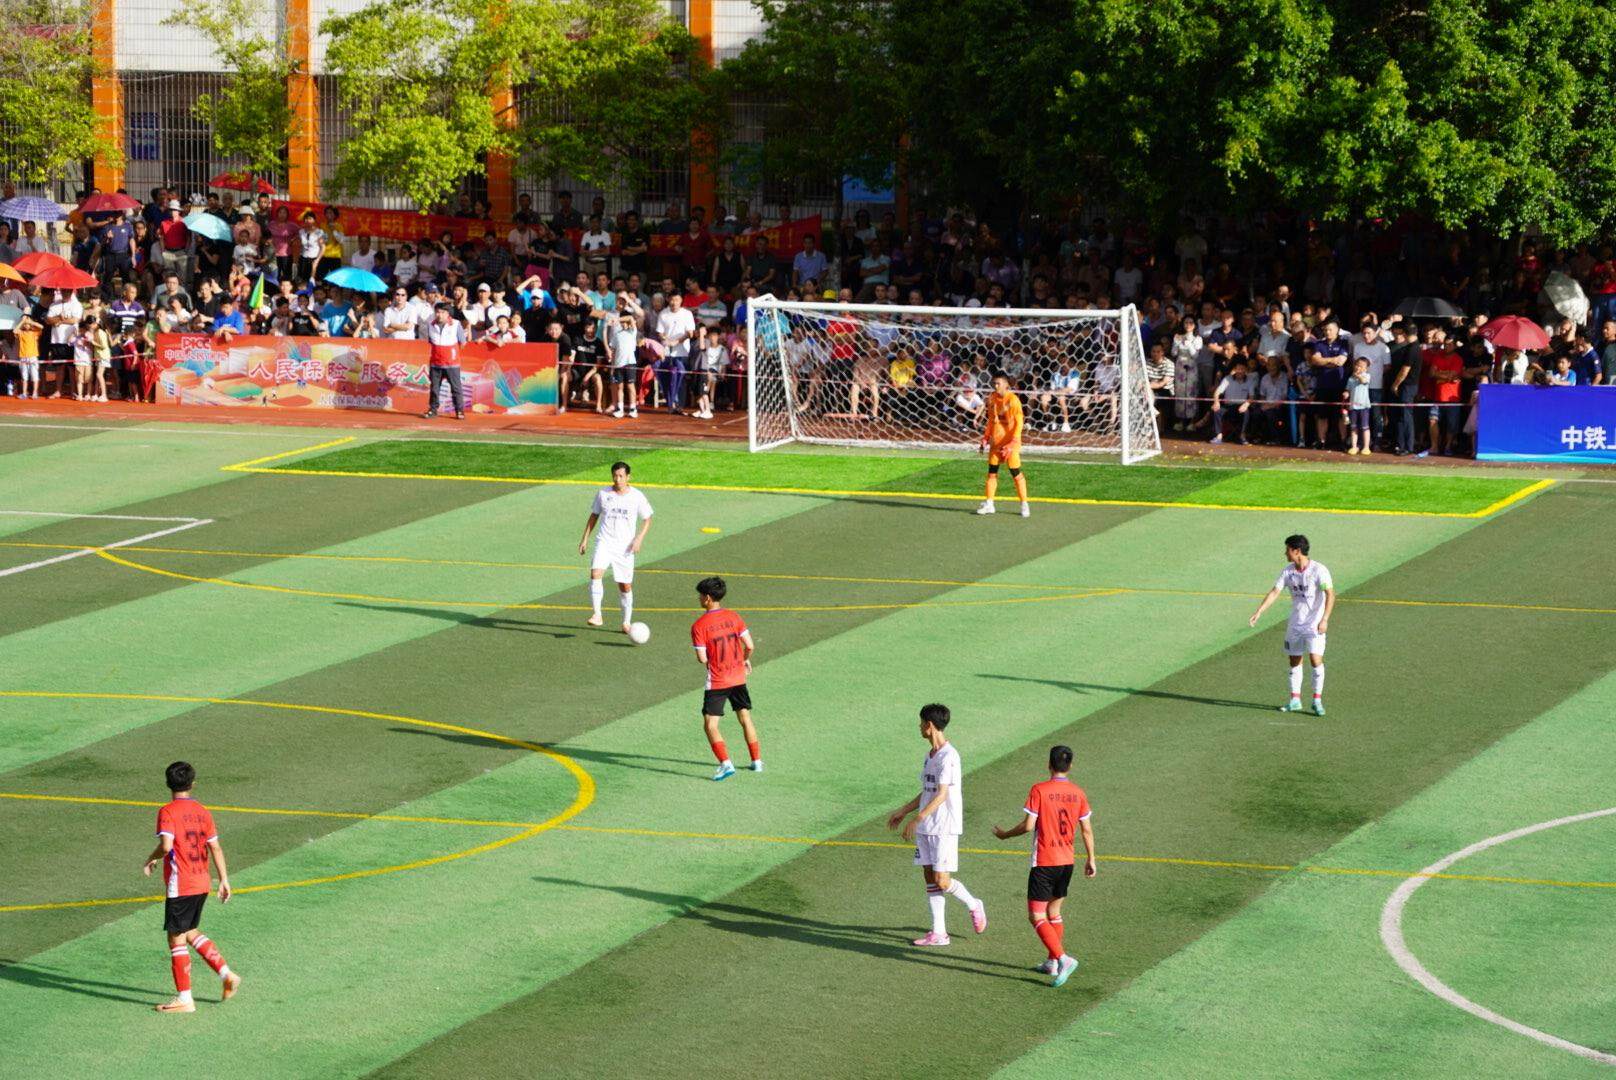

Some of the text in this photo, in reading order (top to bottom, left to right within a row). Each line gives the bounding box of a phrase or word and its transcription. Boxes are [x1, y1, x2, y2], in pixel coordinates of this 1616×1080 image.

[180, 336, 212, 350] PICC
[249, 357, 350, 383] 人民保险
[1058, 807, 1070, 836] 6
